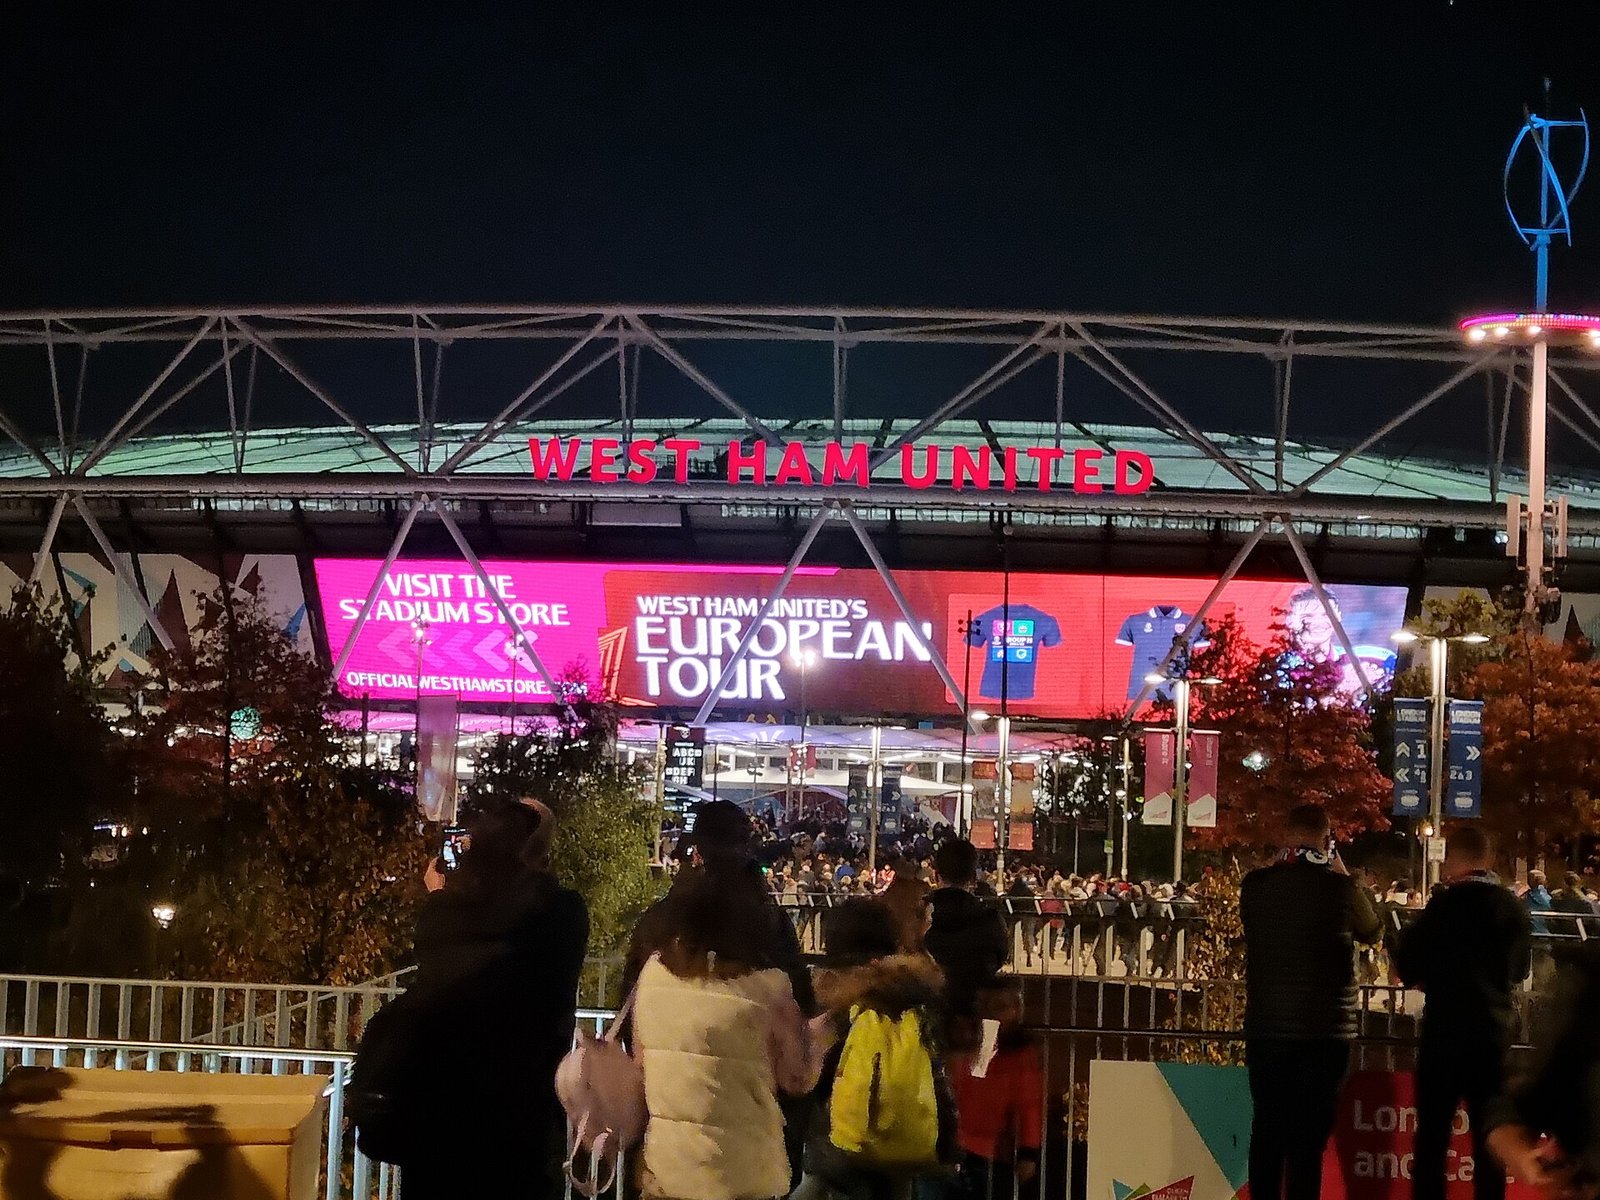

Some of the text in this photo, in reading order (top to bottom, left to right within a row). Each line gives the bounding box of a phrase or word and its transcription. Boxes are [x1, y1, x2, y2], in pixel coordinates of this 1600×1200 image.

[528, 437, 1155, 495] WEST HAM UNITED
[384, 573, 516, 599] VISIT THE
[474, 602, 571, 626] STORE
[635, 595, 869, 619] WEST HAM UNITED'S
[635, 616, 933, 661] EUROPEAN
[635, 656, 786, 700] TOUR
[1417, 743, 1427, 759] 1
[1352, 1099, 1472, 1136] Lono
